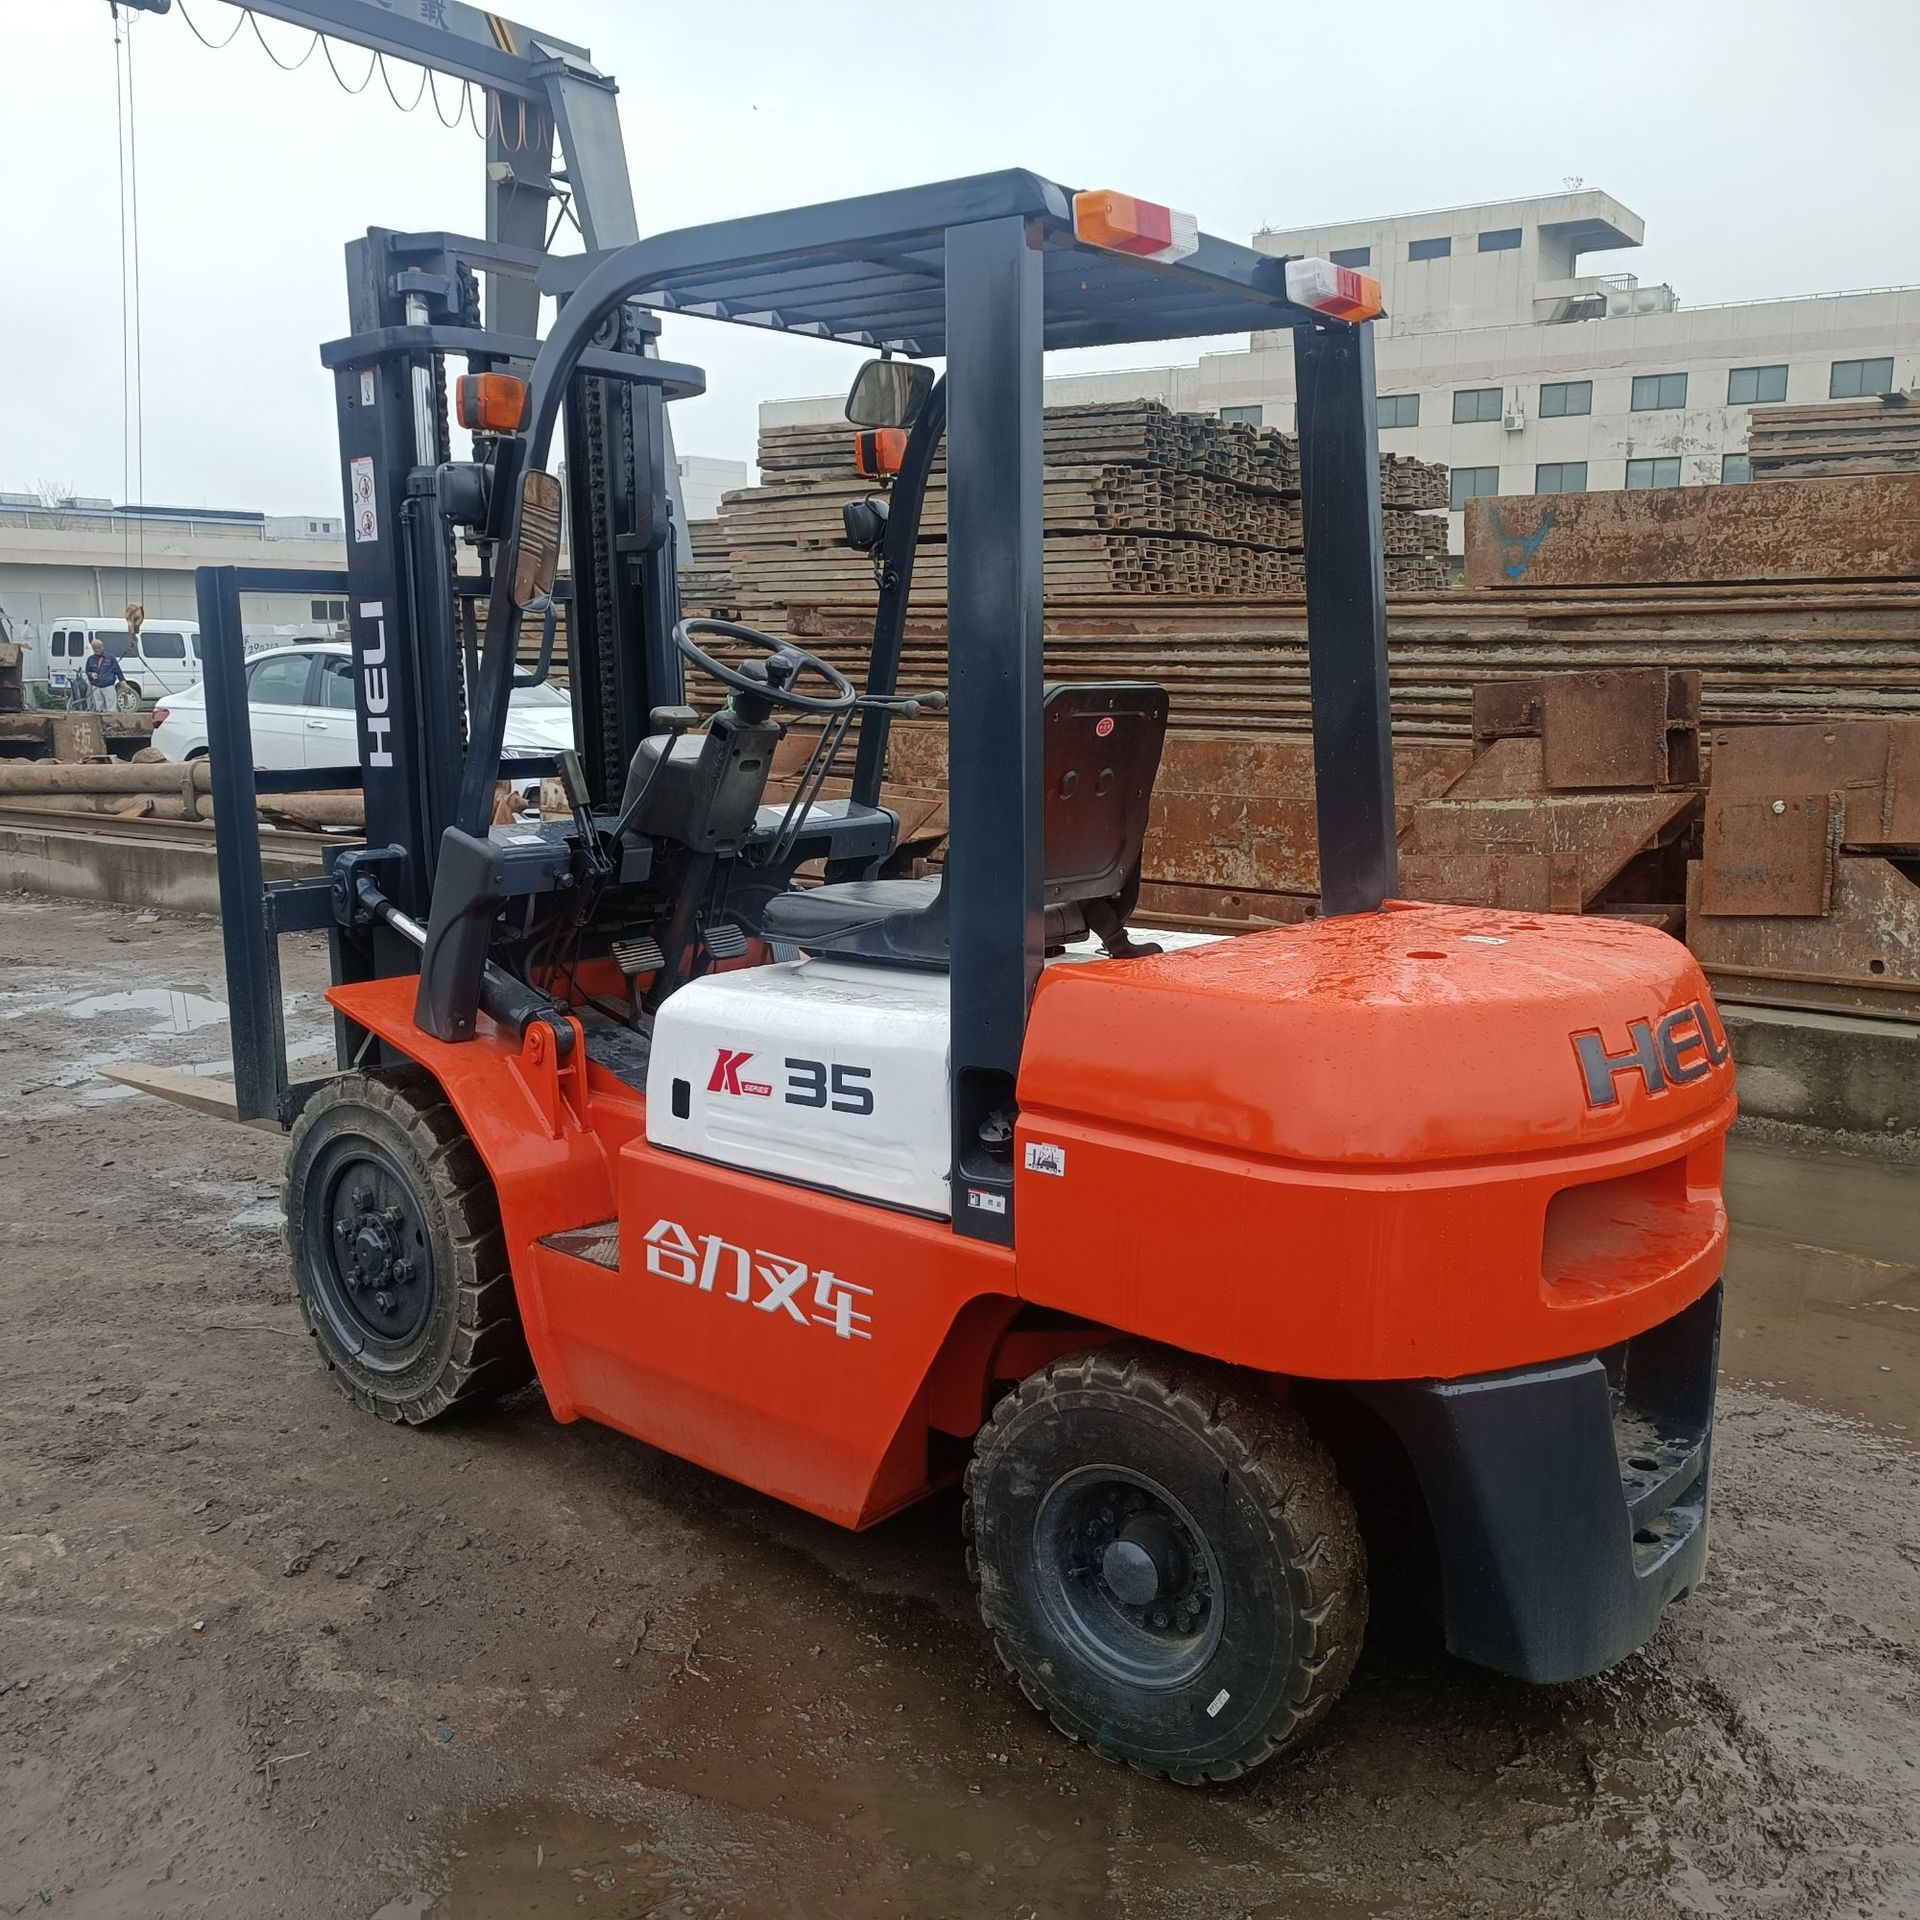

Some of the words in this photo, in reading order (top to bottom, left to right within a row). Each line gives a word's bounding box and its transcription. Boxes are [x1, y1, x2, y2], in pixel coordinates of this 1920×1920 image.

[360, 601, 393, 767] HELI
[707, 1049, 754, 1096] K
[743, 1084, 770, 1095] SERIES
[785, 1057, 874, 1116] 35
[643, 1219, 874, 1339] 合力叉车
